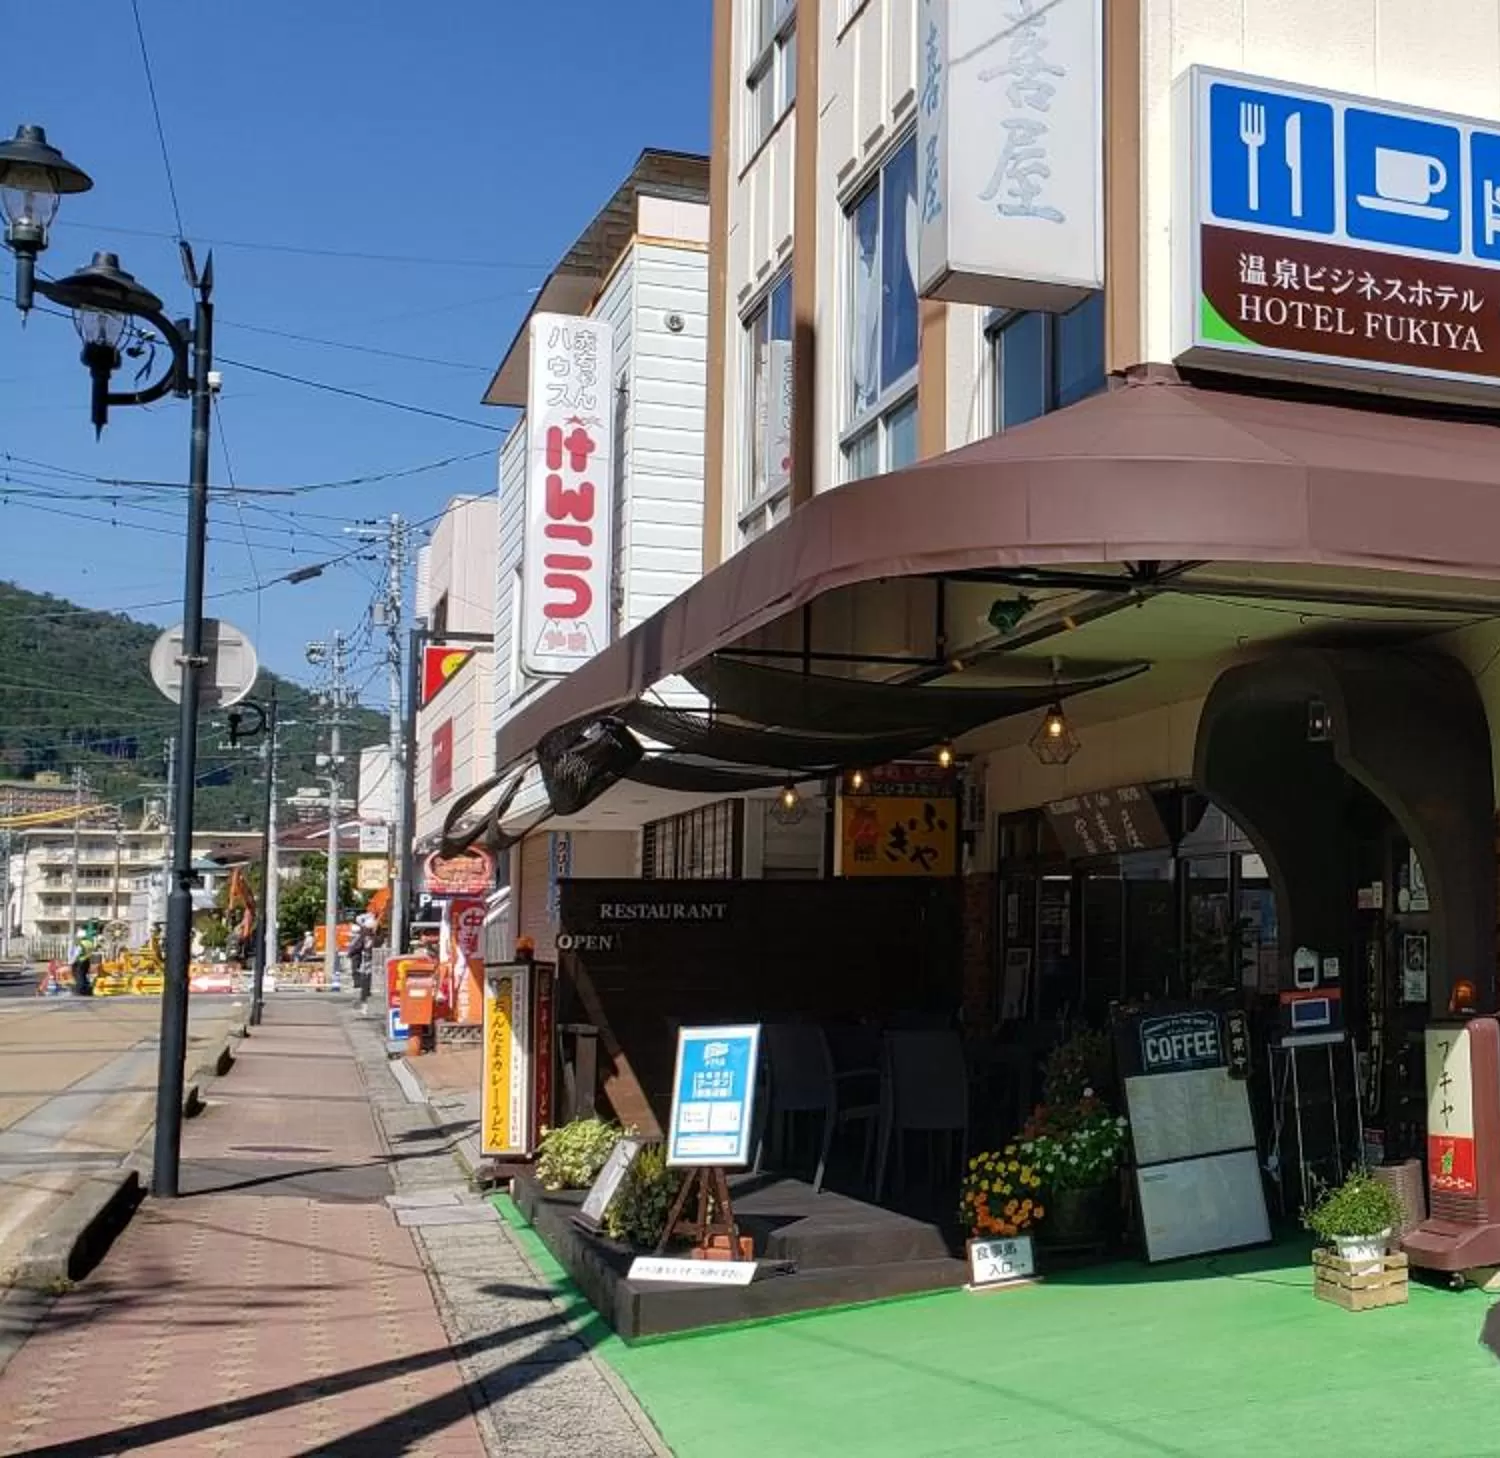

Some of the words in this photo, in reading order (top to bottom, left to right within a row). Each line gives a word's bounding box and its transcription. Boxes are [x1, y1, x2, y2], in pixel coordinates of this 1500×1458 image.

[1238, 252, 1484, 313] 温泉ビジネスホテル
[1238, 293, 1355, 336] HOTEL
[1364, 313, 1485, 353] FUKIYA
[546, 326, 572, 408] ハウス
[544, 425, 596, 619] けんこう
[600, 903, 729, 920] RESTAURANT
[557, 934, 614, 951] OPEN
[1145, 1029, 1218, 1064] COFFEE
[989, 1261, 1013, 1277] 入口
